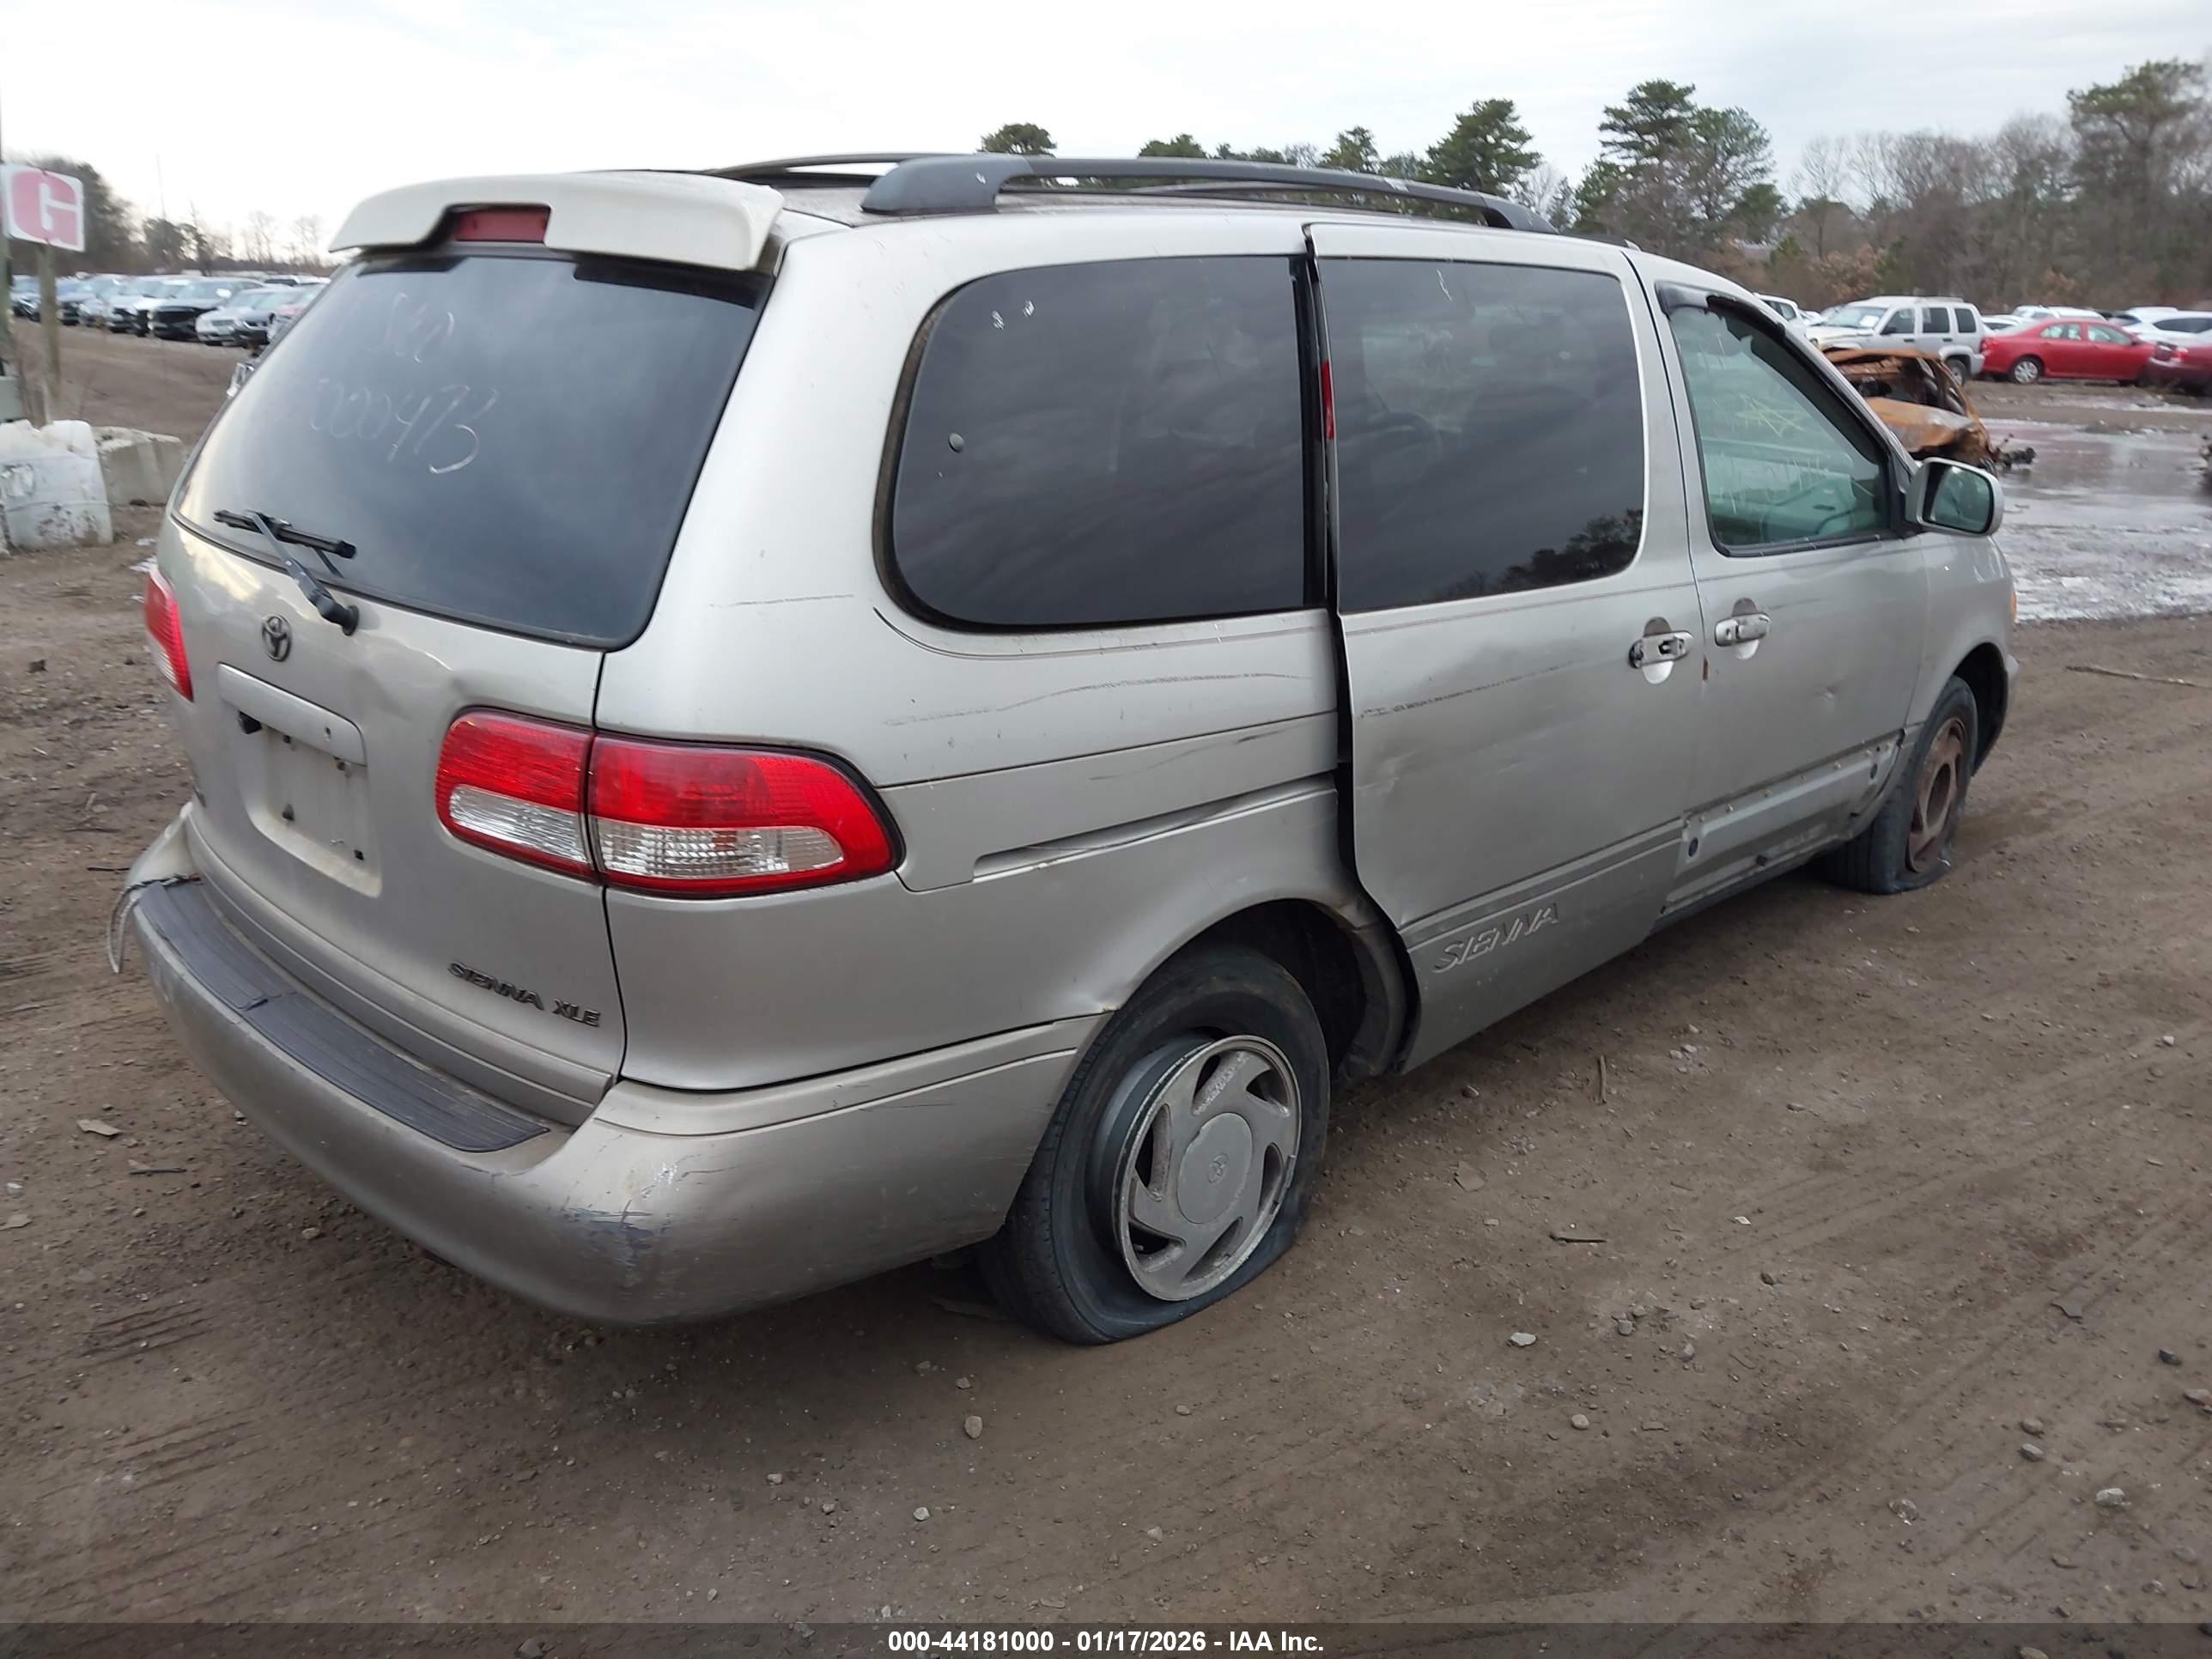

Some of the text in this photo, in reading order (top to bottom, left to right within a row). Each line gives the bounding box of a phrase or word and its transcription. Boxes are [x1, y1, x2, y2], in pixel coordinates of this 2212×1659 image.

[10, 169, 79, 246] G
[447, 961, 601, 1028] SIENNA XLE
